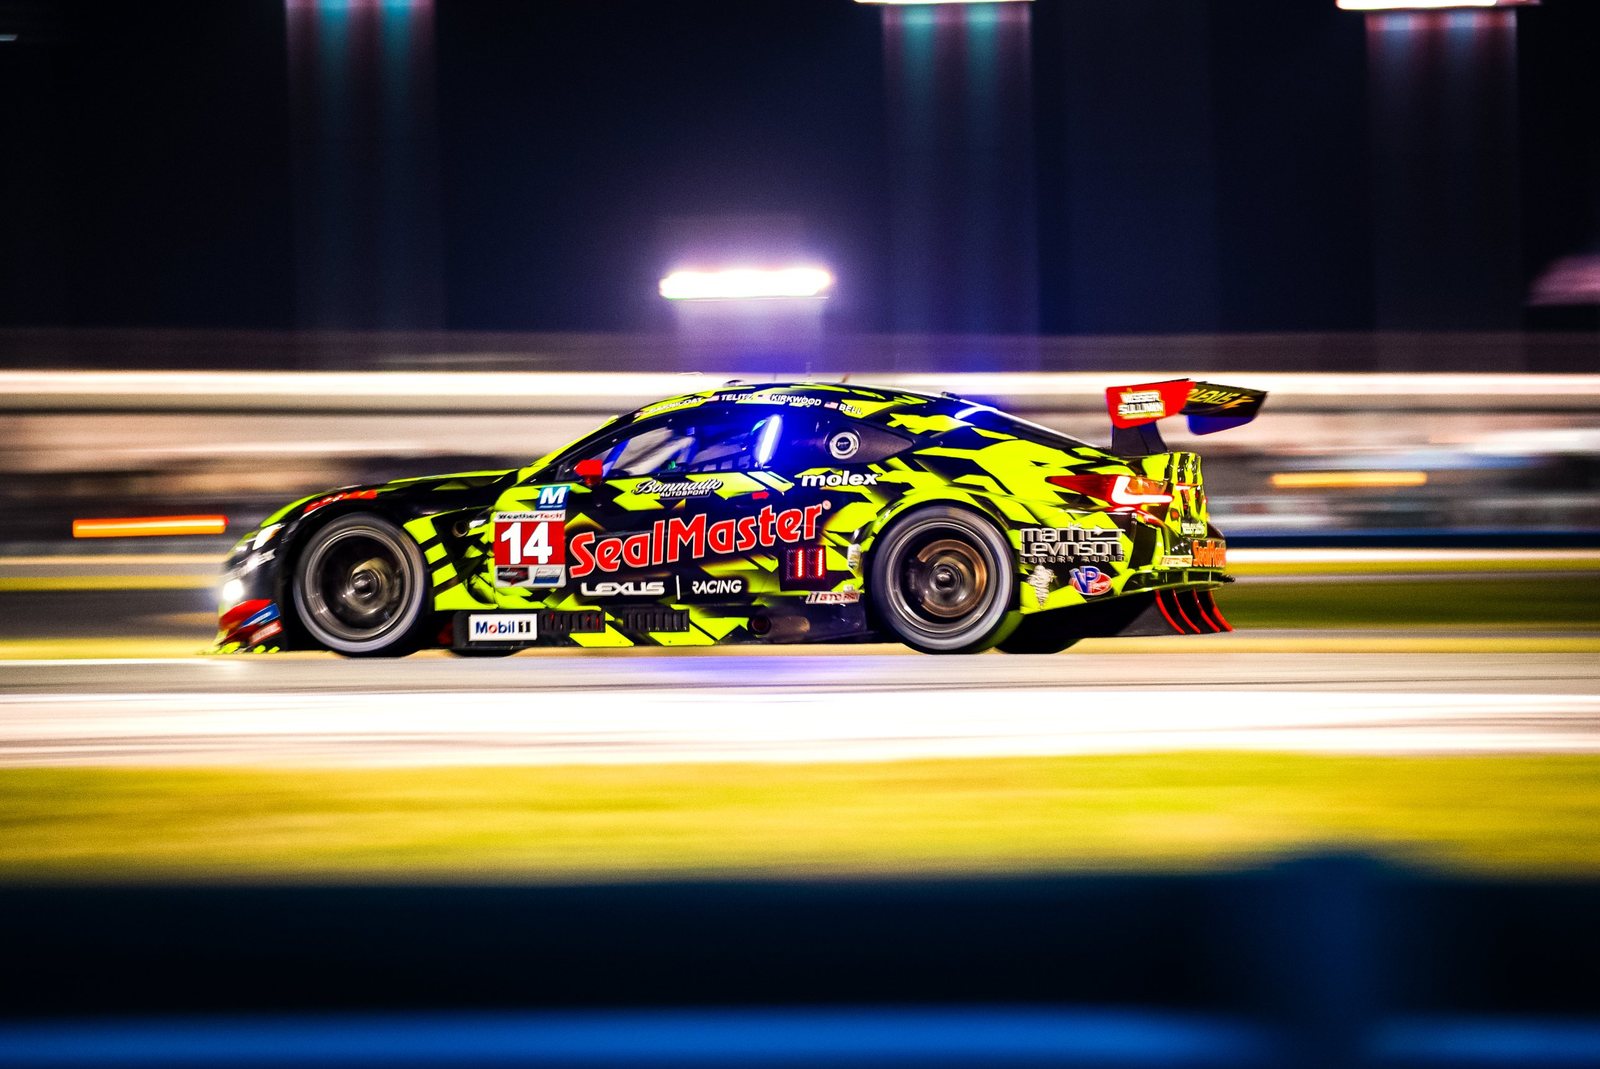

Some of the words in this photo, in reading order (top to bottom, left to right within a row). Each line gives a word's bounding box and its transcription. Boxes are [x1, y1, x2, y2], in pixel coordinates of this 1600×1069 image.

[771, 393, 822, 406] KIRKWOOD
[838, 403, 863, 415] BELL
[801, 470, 878, 487] molex
[540, 486, 568, 504] M
[501, 521, 553, 565] 14
[569, 504, 824, 578] SealMaster
[581, 582, 664, 596] LEXUS
[692, 580, 742, 593] RACING
[475, 620, 516, 635] Mobil
[517, 620, 532, 635] 1
